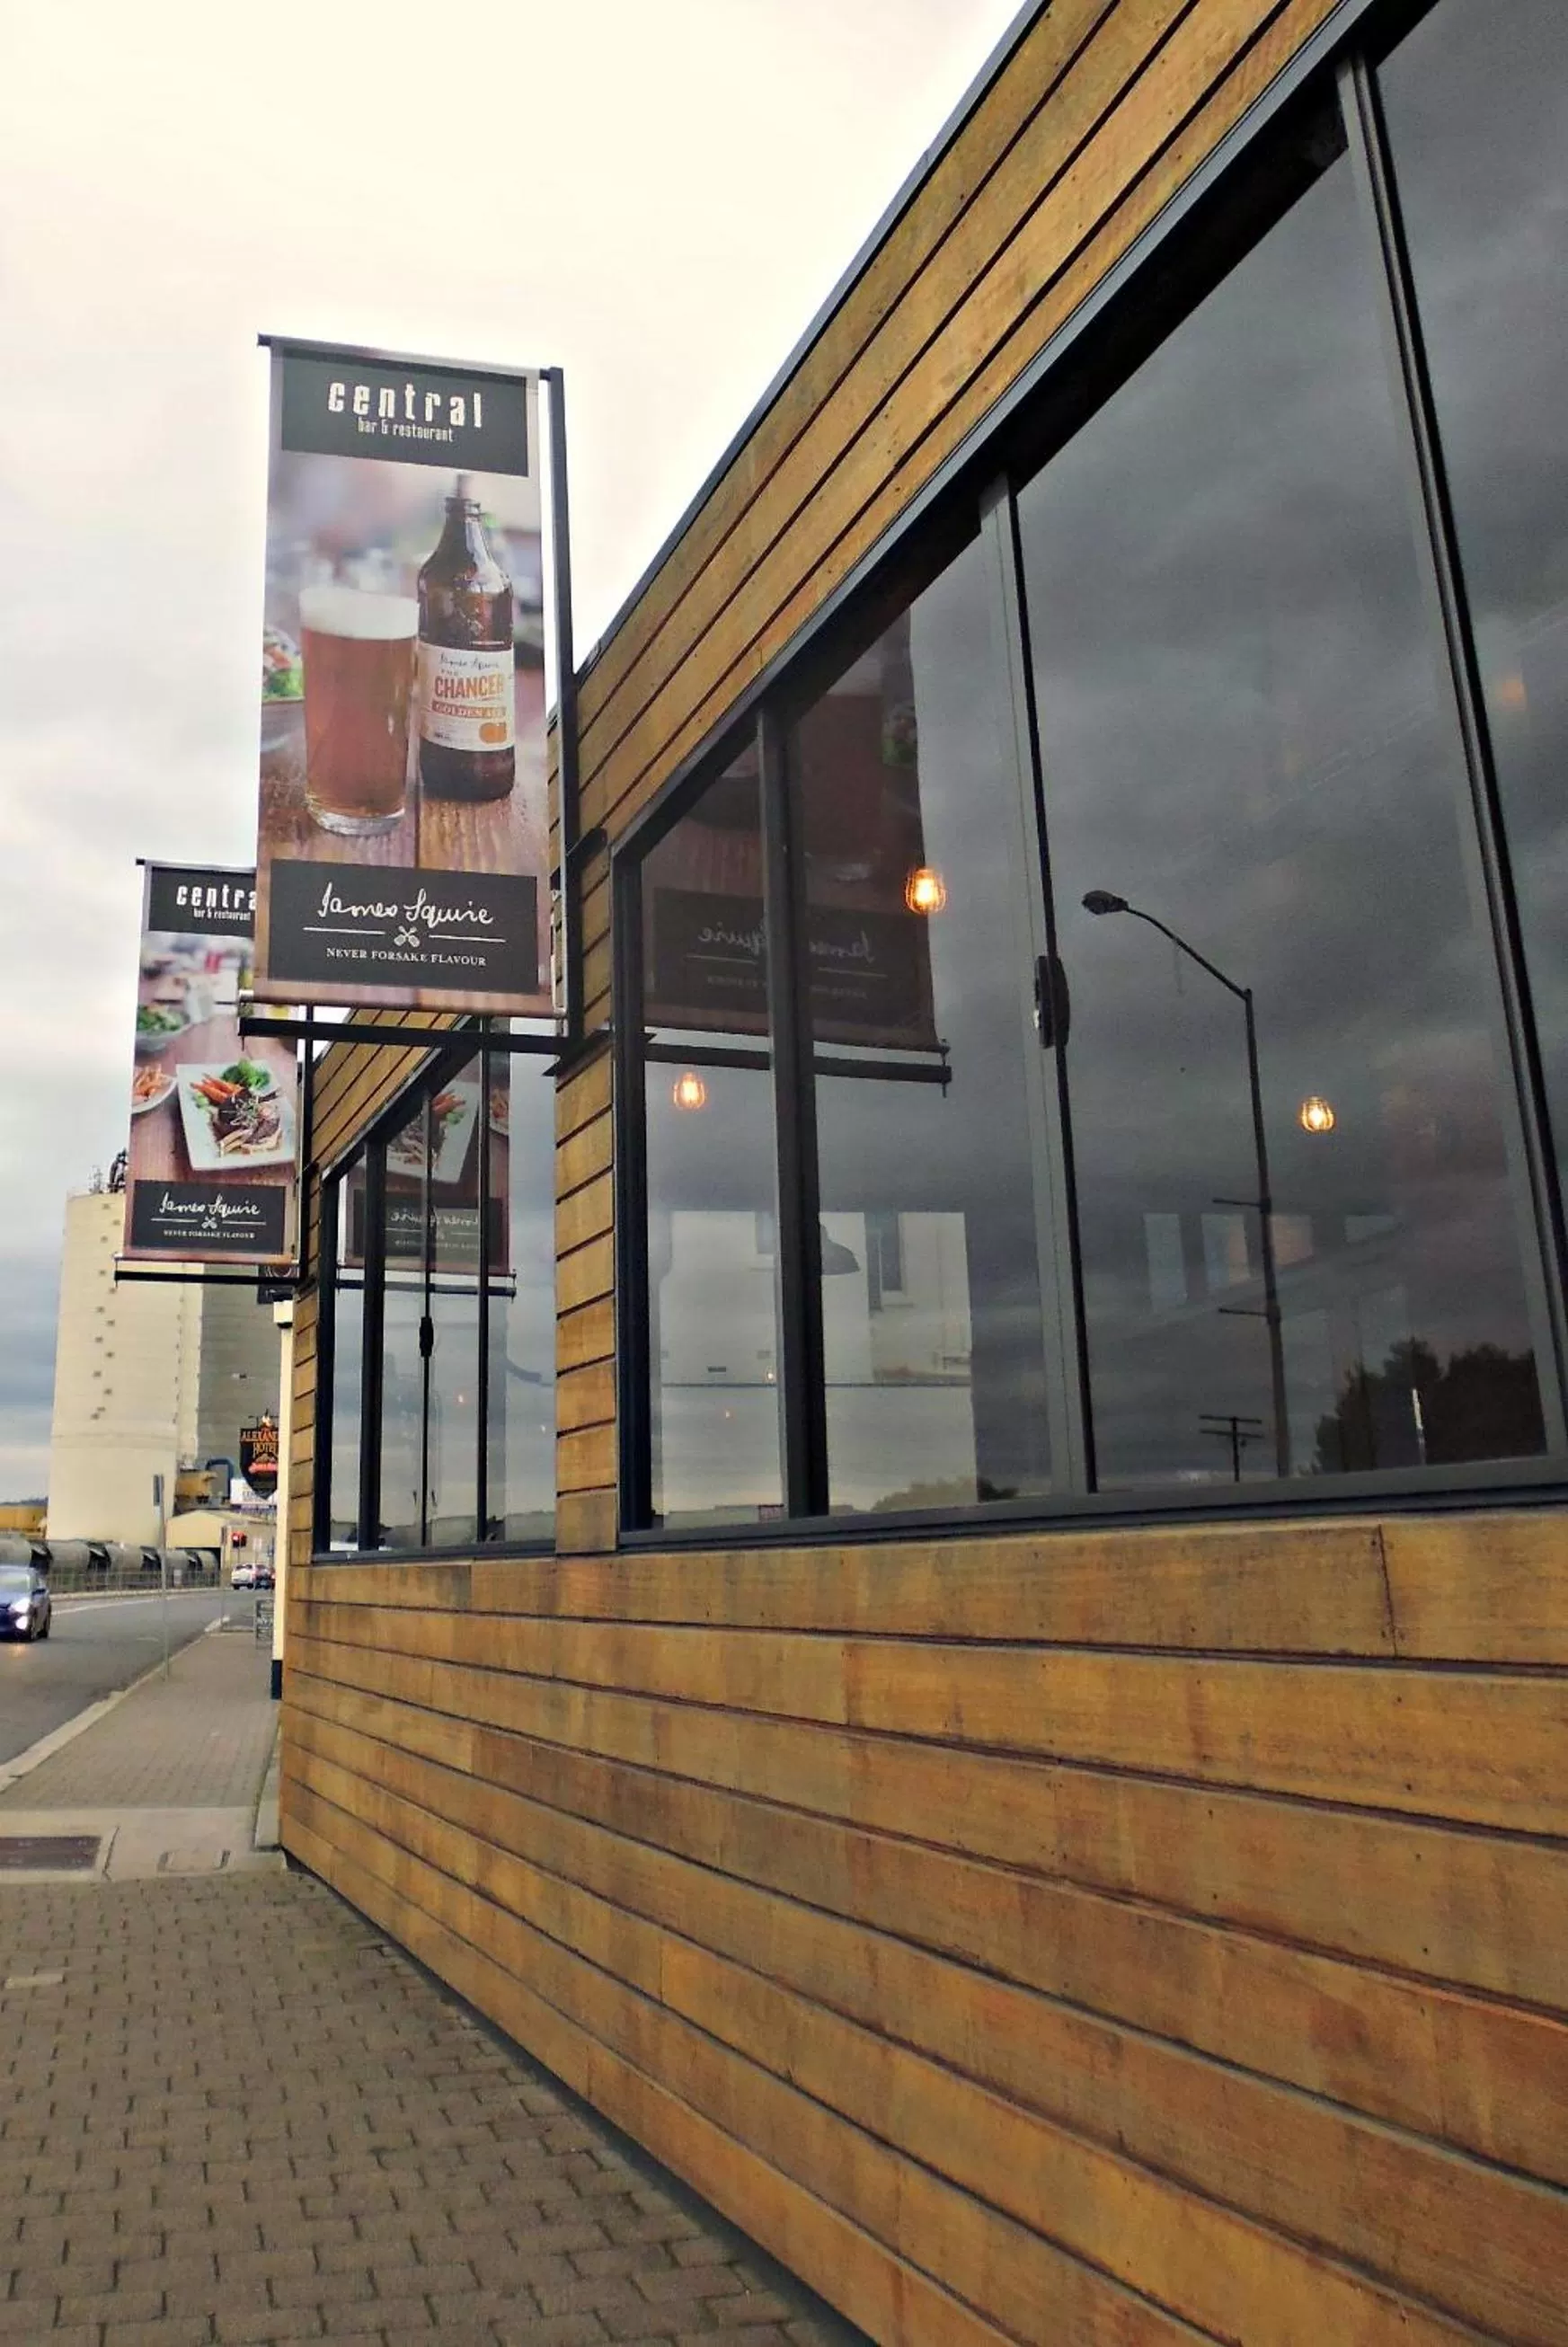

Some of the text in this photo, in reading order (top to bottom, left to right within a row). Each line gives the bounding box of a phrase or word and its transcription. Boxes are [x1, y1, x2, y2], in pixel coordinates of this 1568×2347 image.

[328, 381, 482, 429] central
[358, 416, 454, 443] bar & restaurant
[435, 674, 504, 698] CHANCER
[176, 884, 256, 910] centra
[318, 881, 493, 928] James Squire
[193, 908, 206, 918] bar
[214, 910, 251, 921] restaurant
[326, 947, 486, 966] NEVER FORSAKE FLAVOUR
[159, 1191, 261, 1218] James Squire
